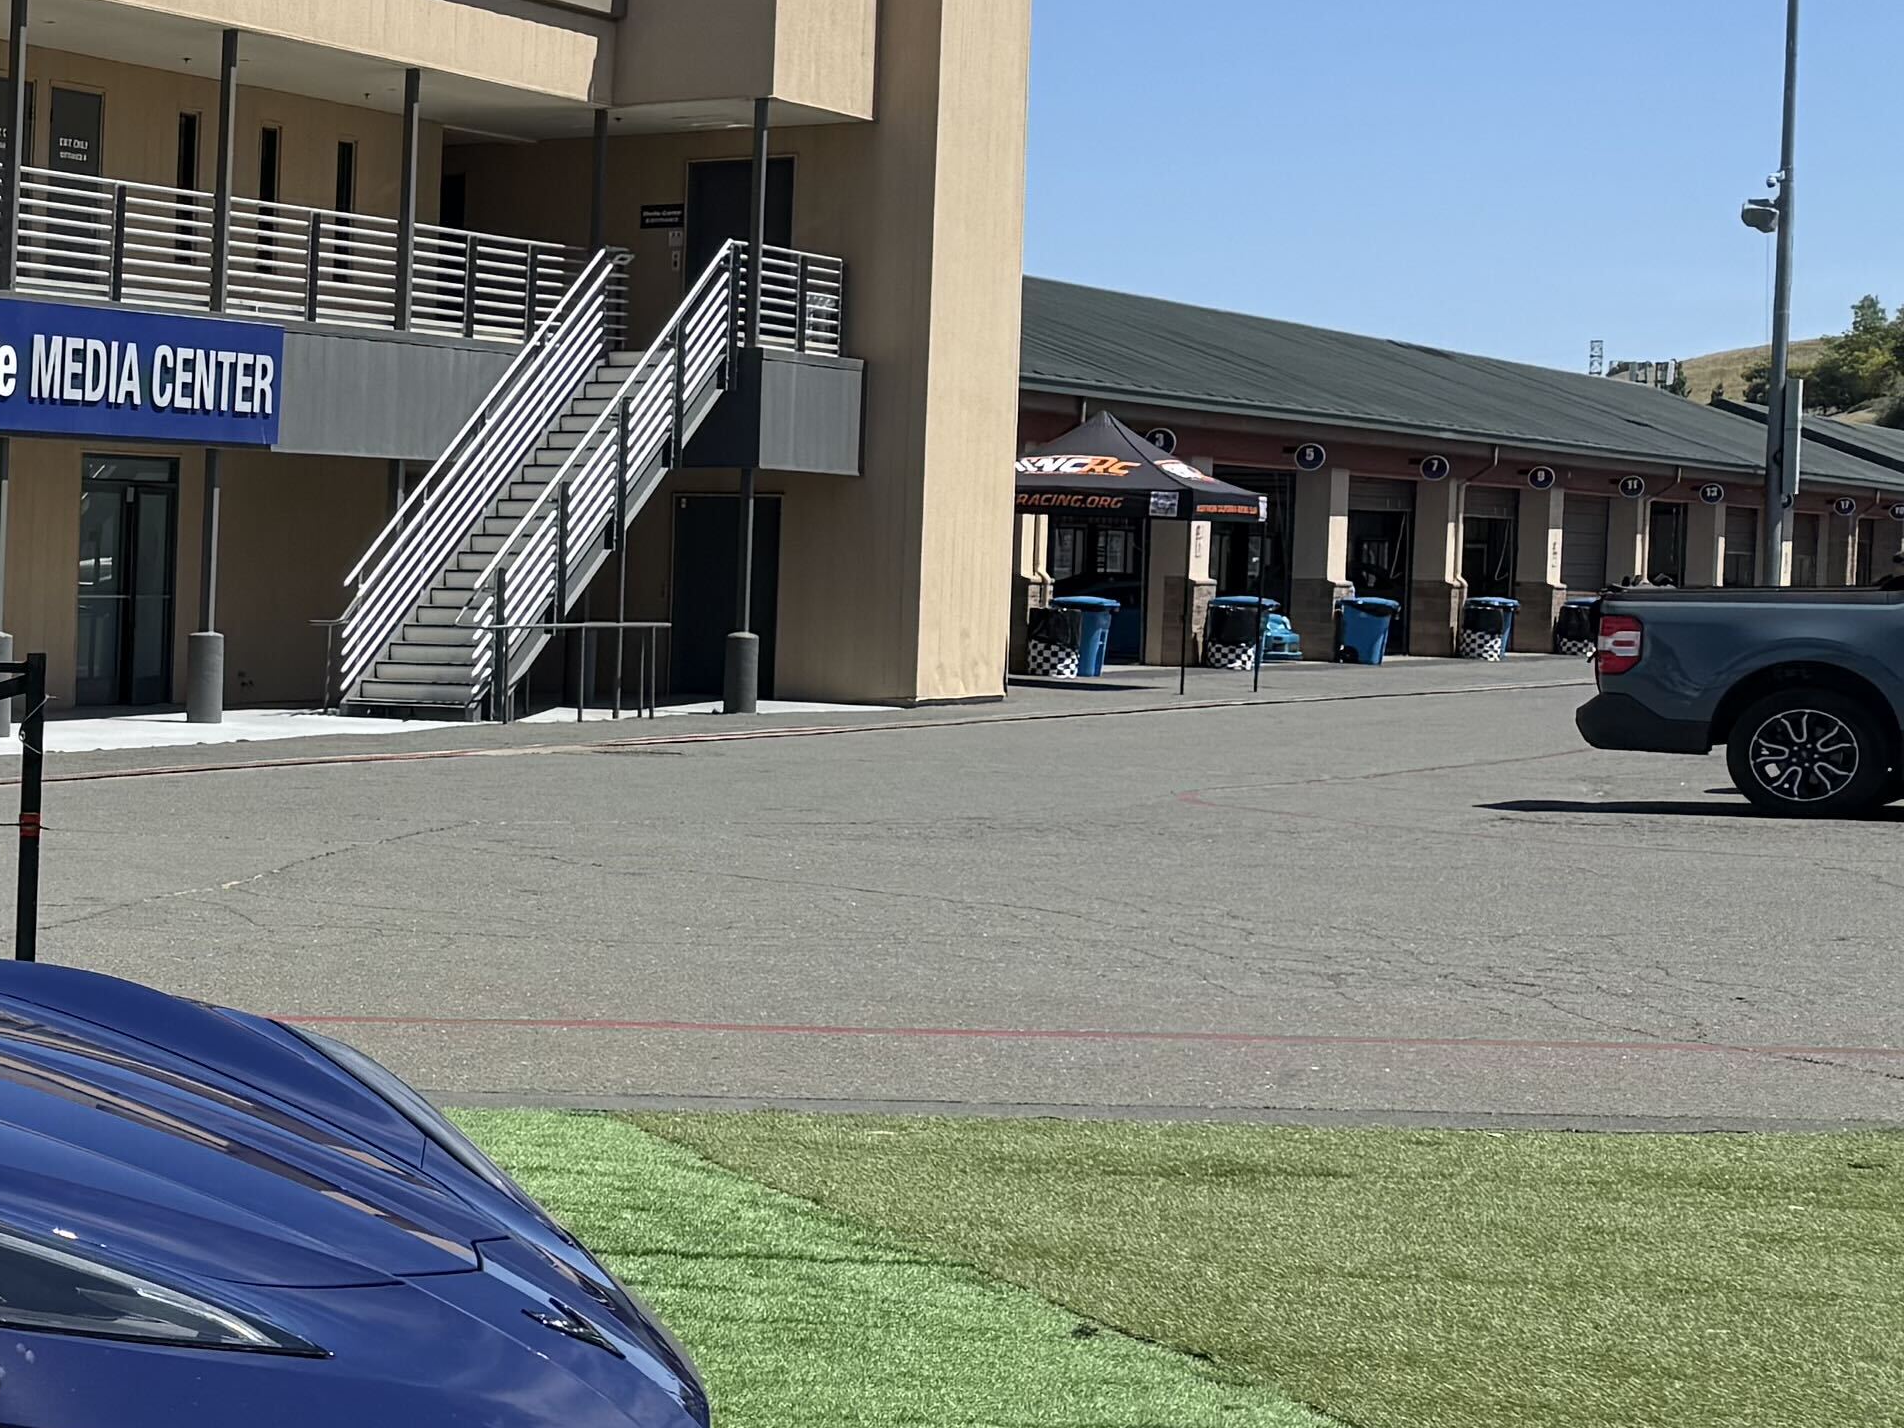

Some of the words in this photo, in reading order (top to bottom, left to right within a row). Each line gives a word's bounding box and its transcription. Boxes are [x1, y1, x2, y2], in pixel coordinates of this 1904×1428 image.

[30, 334, 142, 407] MEDIA
[151, 344, 274, 414] CENTER
[1155, 433, 1164, 447] 3
[1305, 447, 1315, 461] 5
[1431, 460, 1439, 471] 7
[1627, 479, 1638, 489] 11
